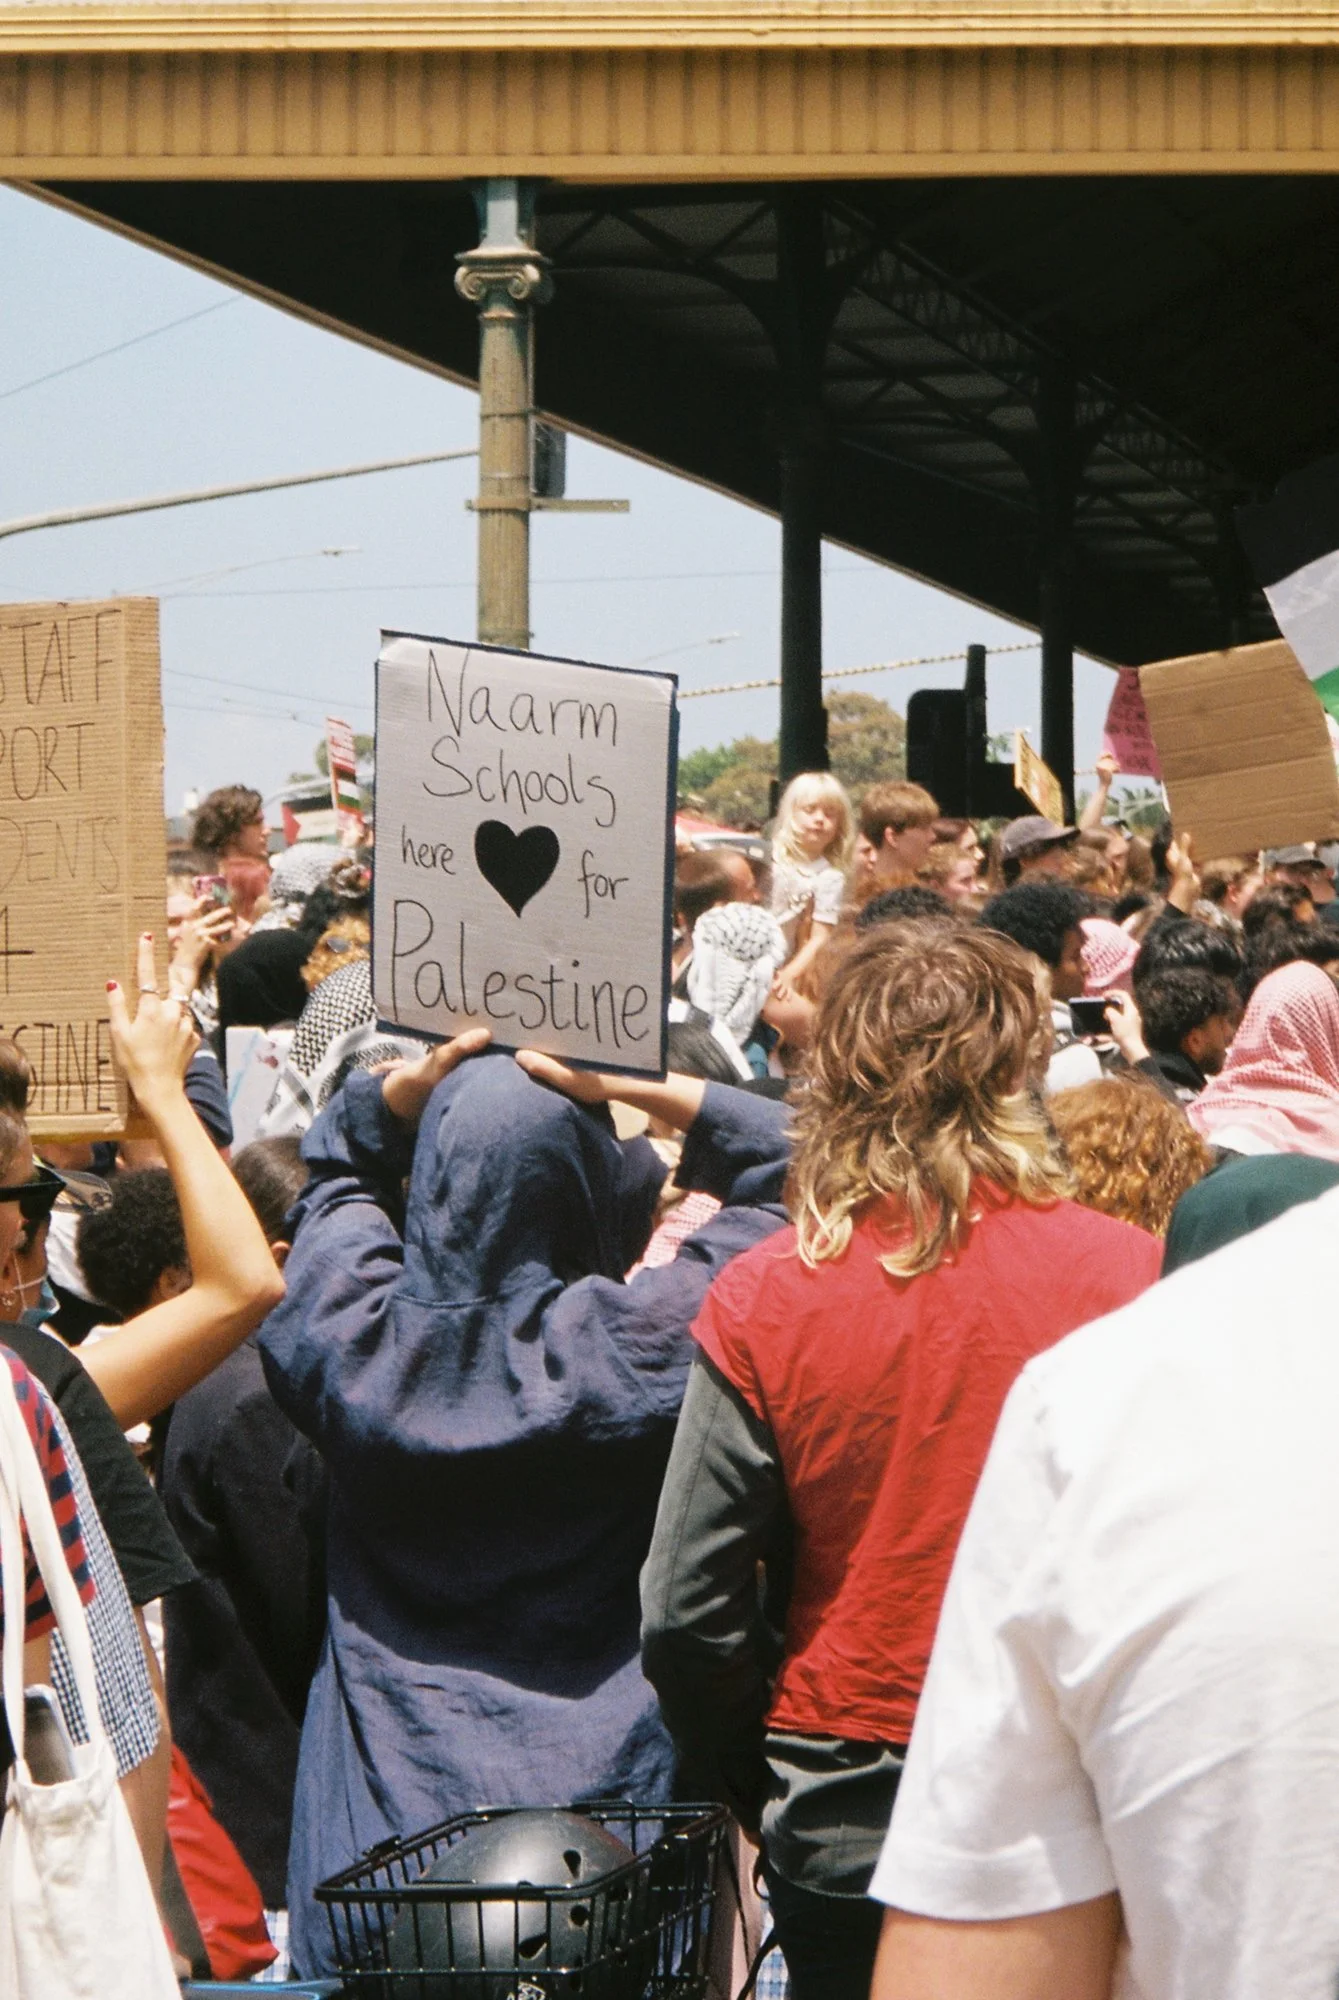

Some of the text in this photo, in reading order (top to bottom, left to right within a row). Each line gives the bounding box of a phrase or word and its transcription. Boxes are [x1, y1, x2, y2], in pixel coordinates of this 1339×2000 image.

[0, 608, 122, 705] TAFF
[427, 648, 618, 747] Naarm
[0, 722, 96, 801] ORT
[422, 735, 617, 828] Schools
[401, 824, 630, 919] here for
[389, 898, 650, 1049] Palestine
[0, 1019, 112, 1113] STINE
